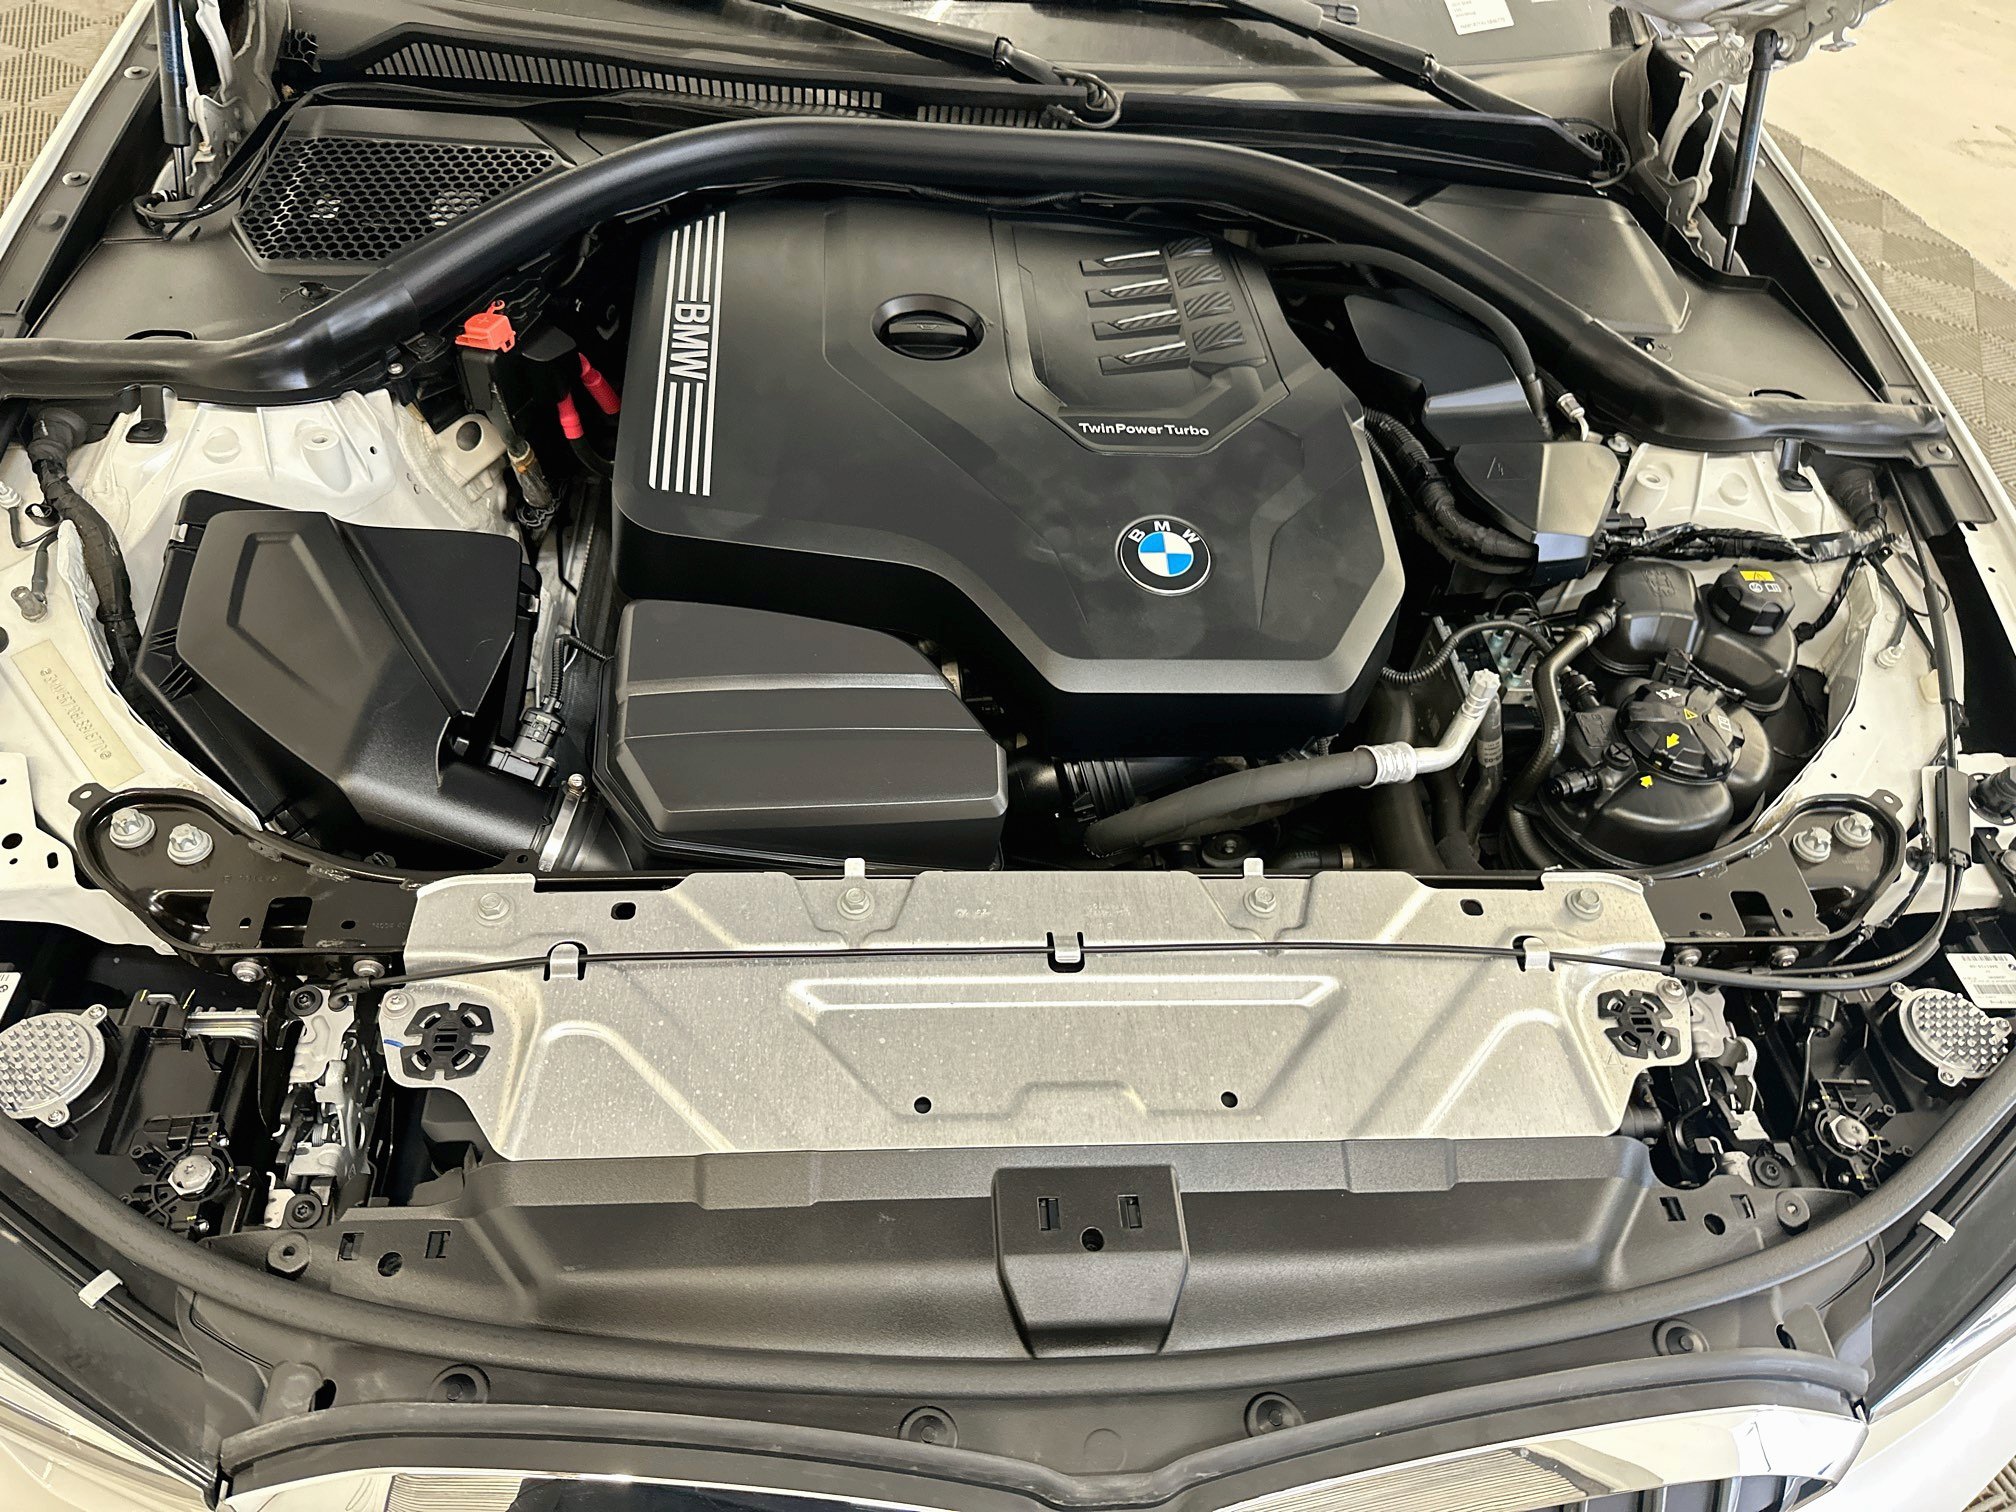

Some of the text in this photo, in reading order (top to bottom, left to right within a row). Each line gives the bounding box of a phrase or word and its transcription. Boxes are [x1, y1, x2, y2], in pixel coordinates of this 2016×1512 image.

[669, 302, 712, 381] BMW
[1078, 422, 1210, 437] TwinPower Turbo
[1127, 520, 1201, 545] BMW
